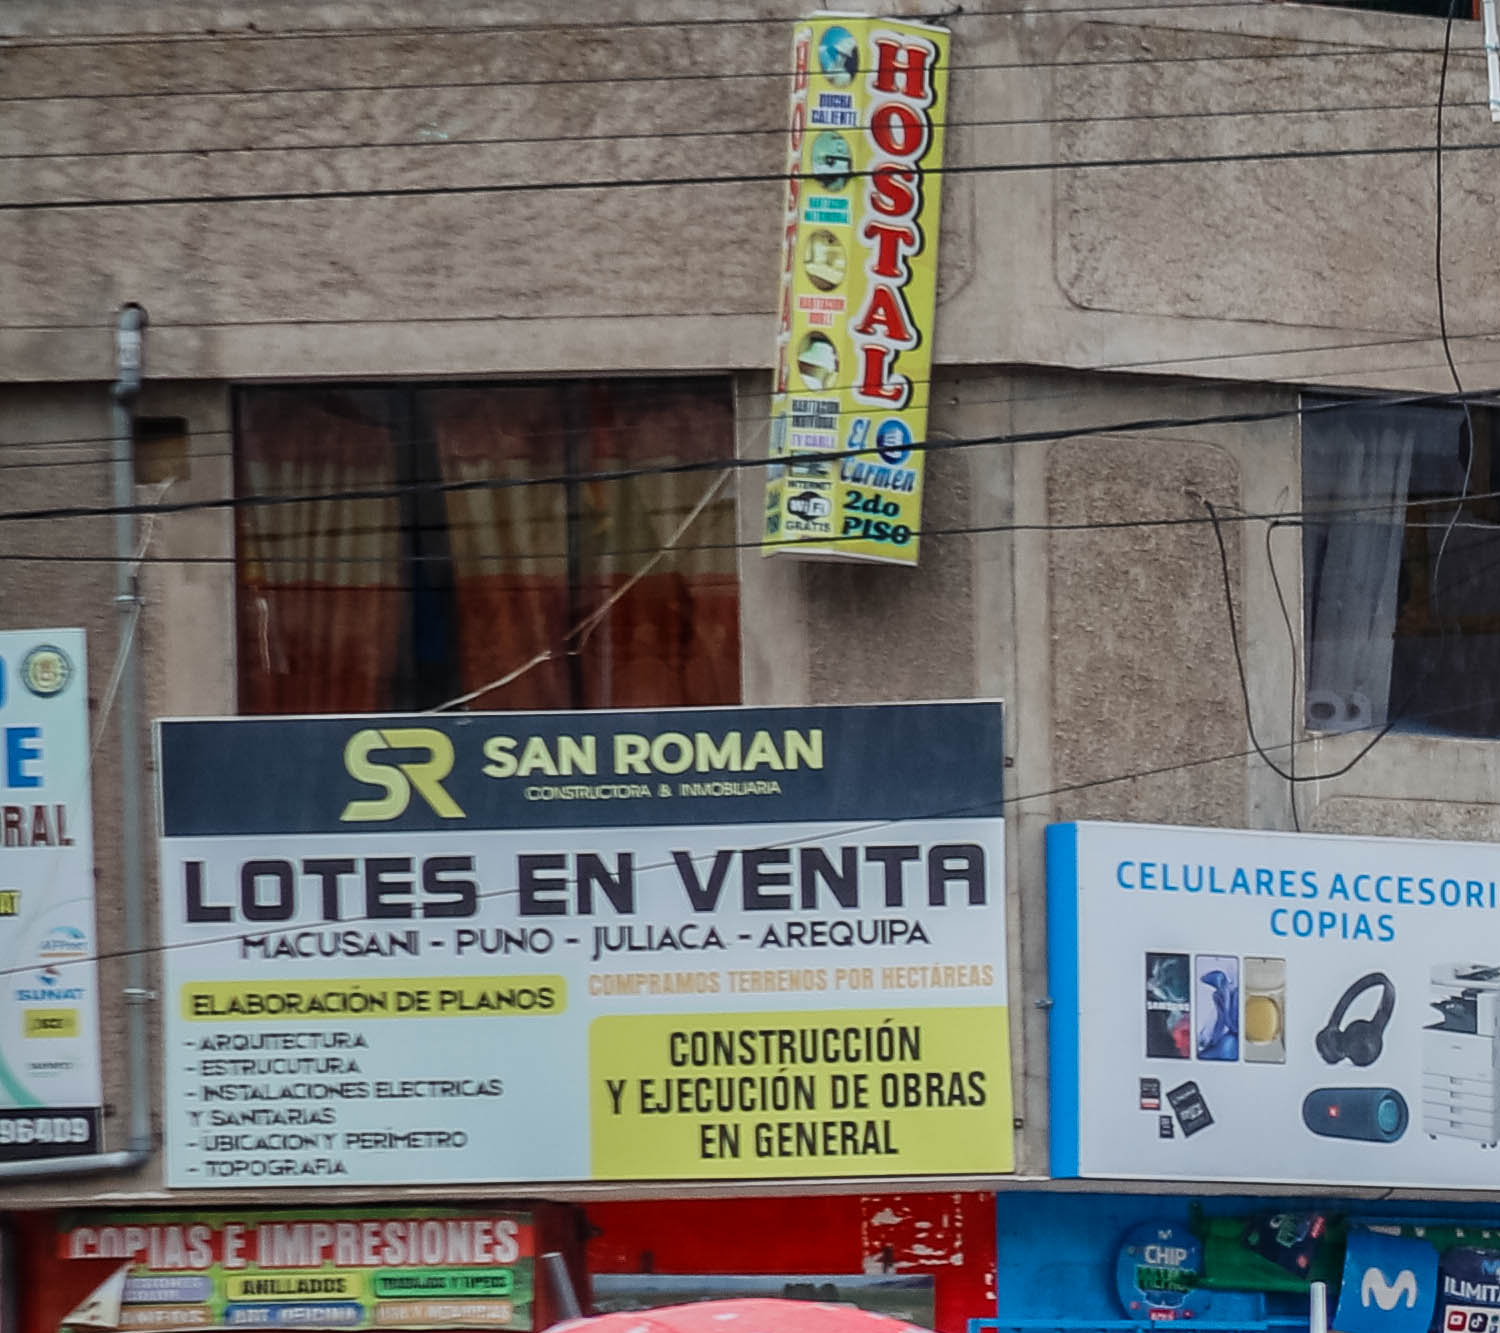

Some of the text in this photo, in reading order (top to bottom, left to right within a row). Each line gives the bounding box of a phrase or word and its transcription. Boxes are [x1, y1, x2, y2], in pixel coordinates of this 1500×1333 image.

[855, 36, 933, 405] HOSTAL
[843, 489, 899, 517] 2do
[785, 520, 832, 533] GRATIS
[841, 515, 911, 545] PISO
[482, 728, 825, 778] SAN ROMAN
[524, 779, 782, 801] CONSTRUCTORA & INMOBILIARIA
[184, 843, 988, 923] LOTES EN VENTA
[1116, 860, 1319, 899] CELULARES
[241, 919, 931, 962] MACUSANI PUNO JULIACA AREQUIPA
[1270, 907, 1395, 942] COPIAS
[588, 961, 994, 997] COMPRAMOS TERRENOS POR HECTÁREAS
[192, 985, 556, 1016] ELABORACIÓN DE PLANOS
[200, 1031, 368, 1051] ARQUITECTURA
[669, 1018, 922, 1067] CONSTRUCCIÓN
[203, 1078, 505, 1101] INSTALACIONES ELECTRICAS
[606, 1068, 988, 1115] Y EJECUCIÓN DE OBRAS
[211, 1107, 337, 1127] SANITARIAS
[700, 1119, 899, 1159] EN GENERAL
[222, 1223, 247, 1268] E
[257, 1217, 520, 1267] IMPRESIONES
[1144, 1245, 1187, 1266] CHIP
[241, 1277, 346, 1296] ANILLADOS
